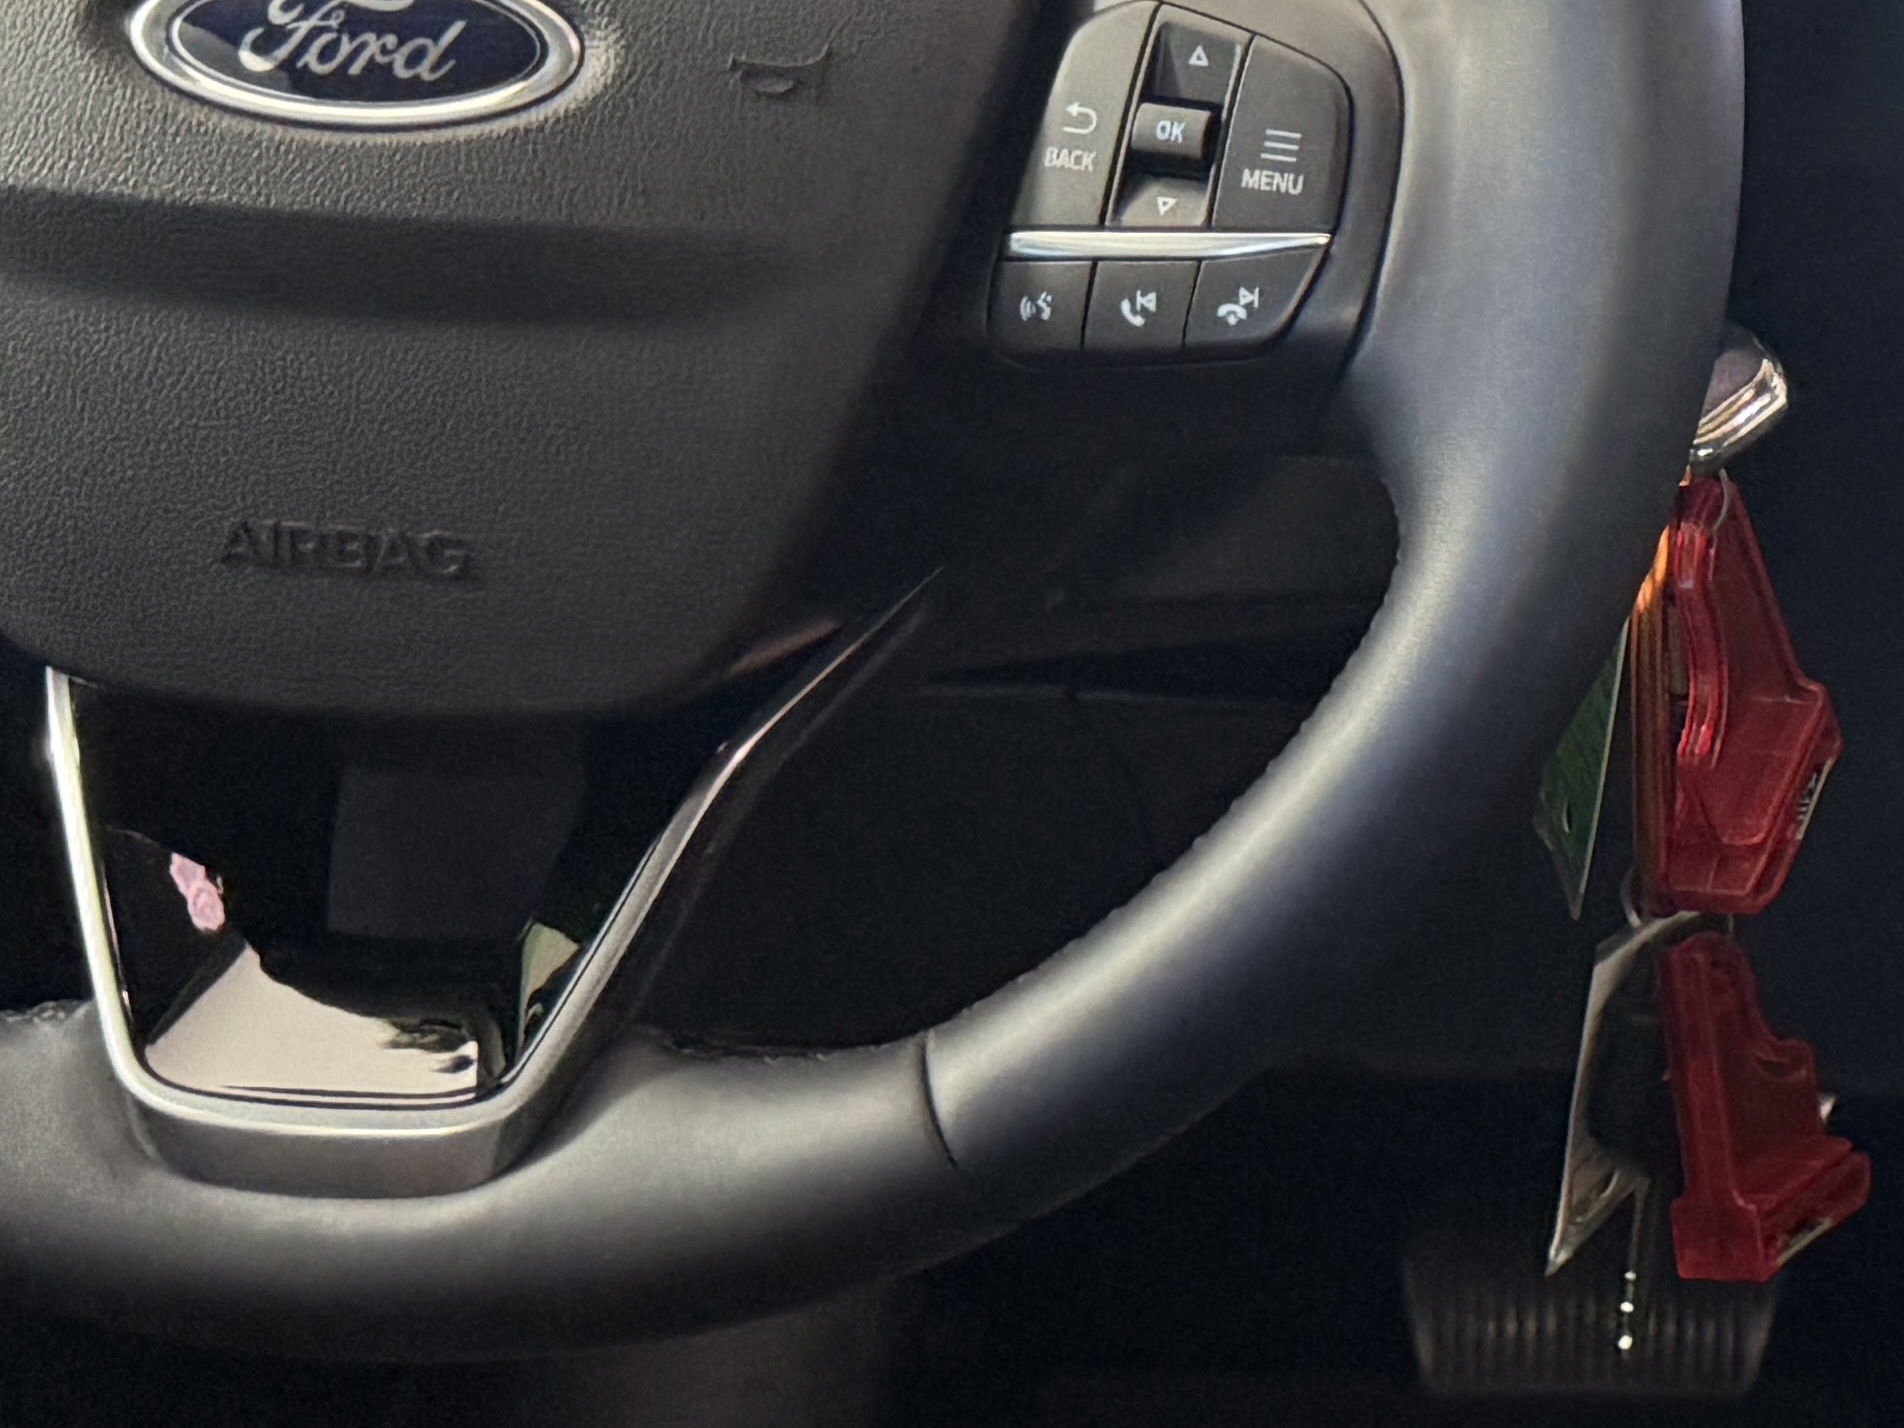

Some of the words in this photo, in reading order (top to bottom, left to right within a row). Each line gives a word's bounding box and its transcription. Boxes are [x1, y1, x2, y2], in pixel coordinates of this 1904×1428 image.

[1155, 120, 1186, 143] OK
[1044, 145, 1097, 172] BACK
[1241, 168, 1304, 196] MENU
[215, 517, 468, 575] AIRBAG
